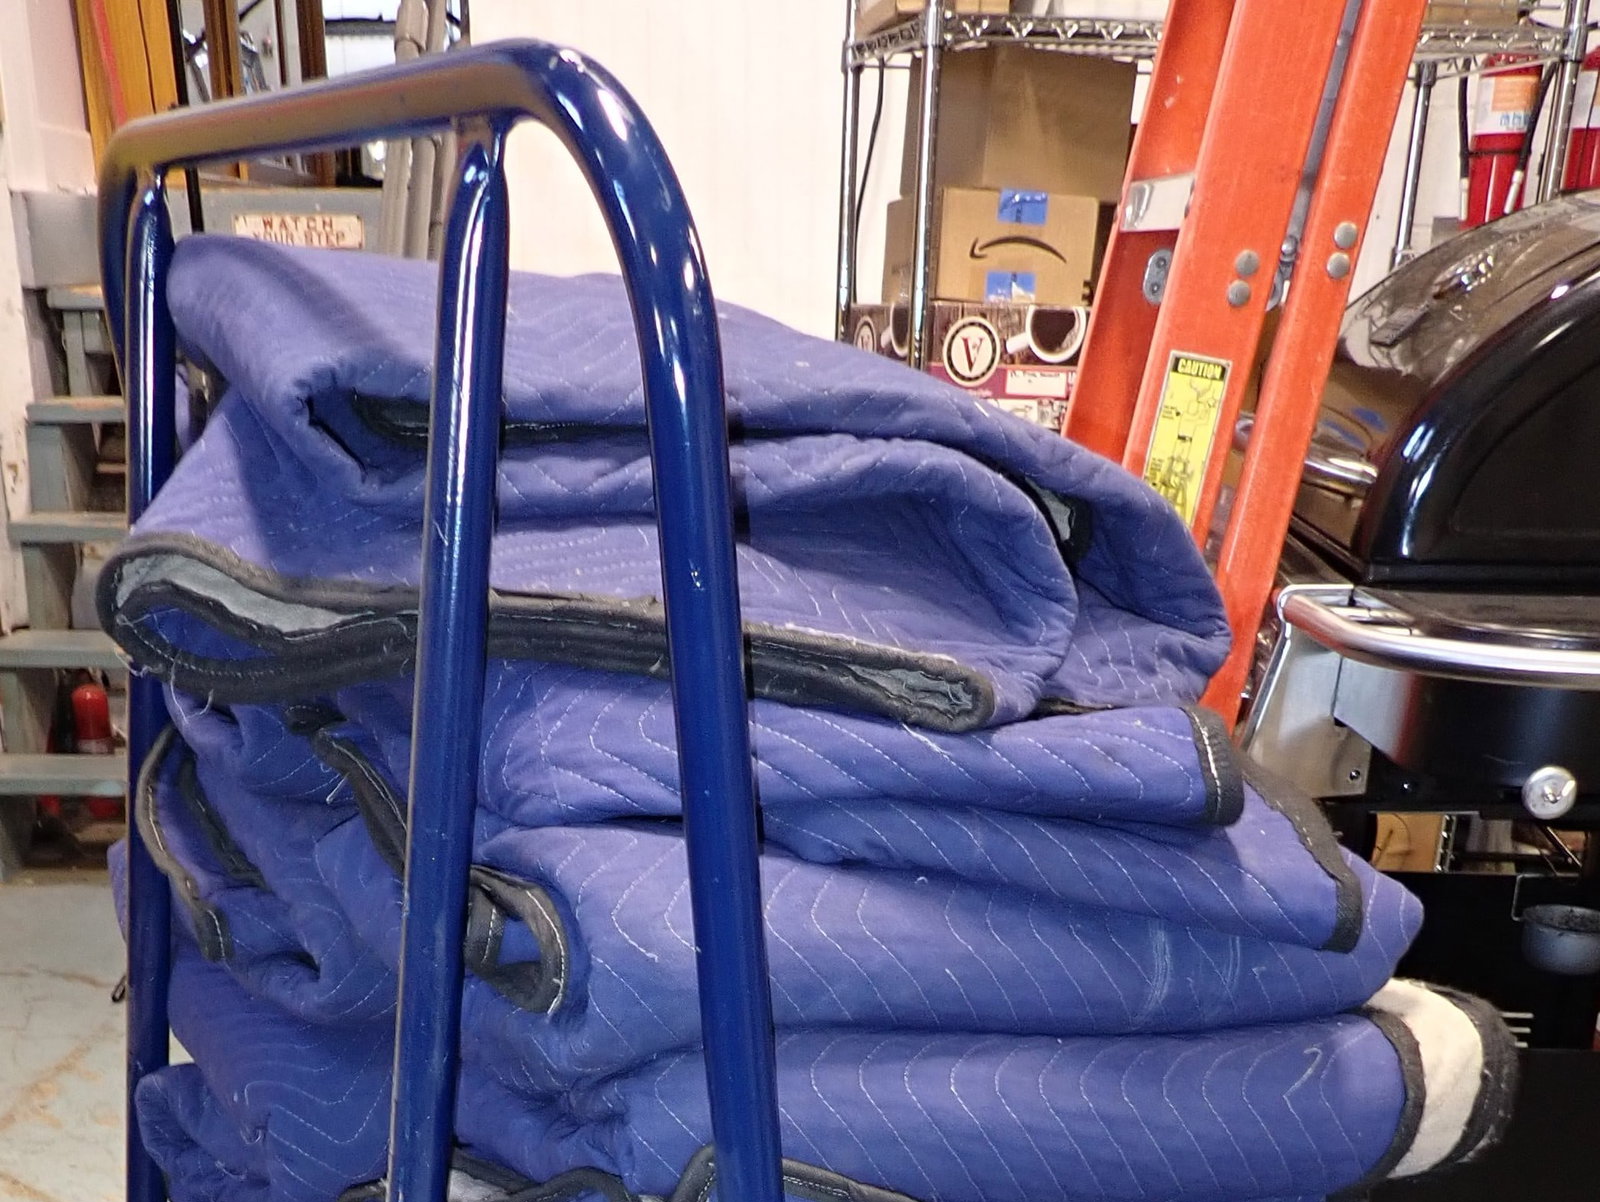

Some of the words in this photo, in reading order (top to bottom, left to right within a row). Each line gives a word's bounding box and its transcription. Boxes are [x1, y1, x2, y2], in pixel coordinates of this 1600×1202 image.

[262, 215, 333, 231] WATCH
[304, 231, 345, 247] STEP
[962, 336, 984, 373] V
[1177, 358, 1222, 379] CAUTION
